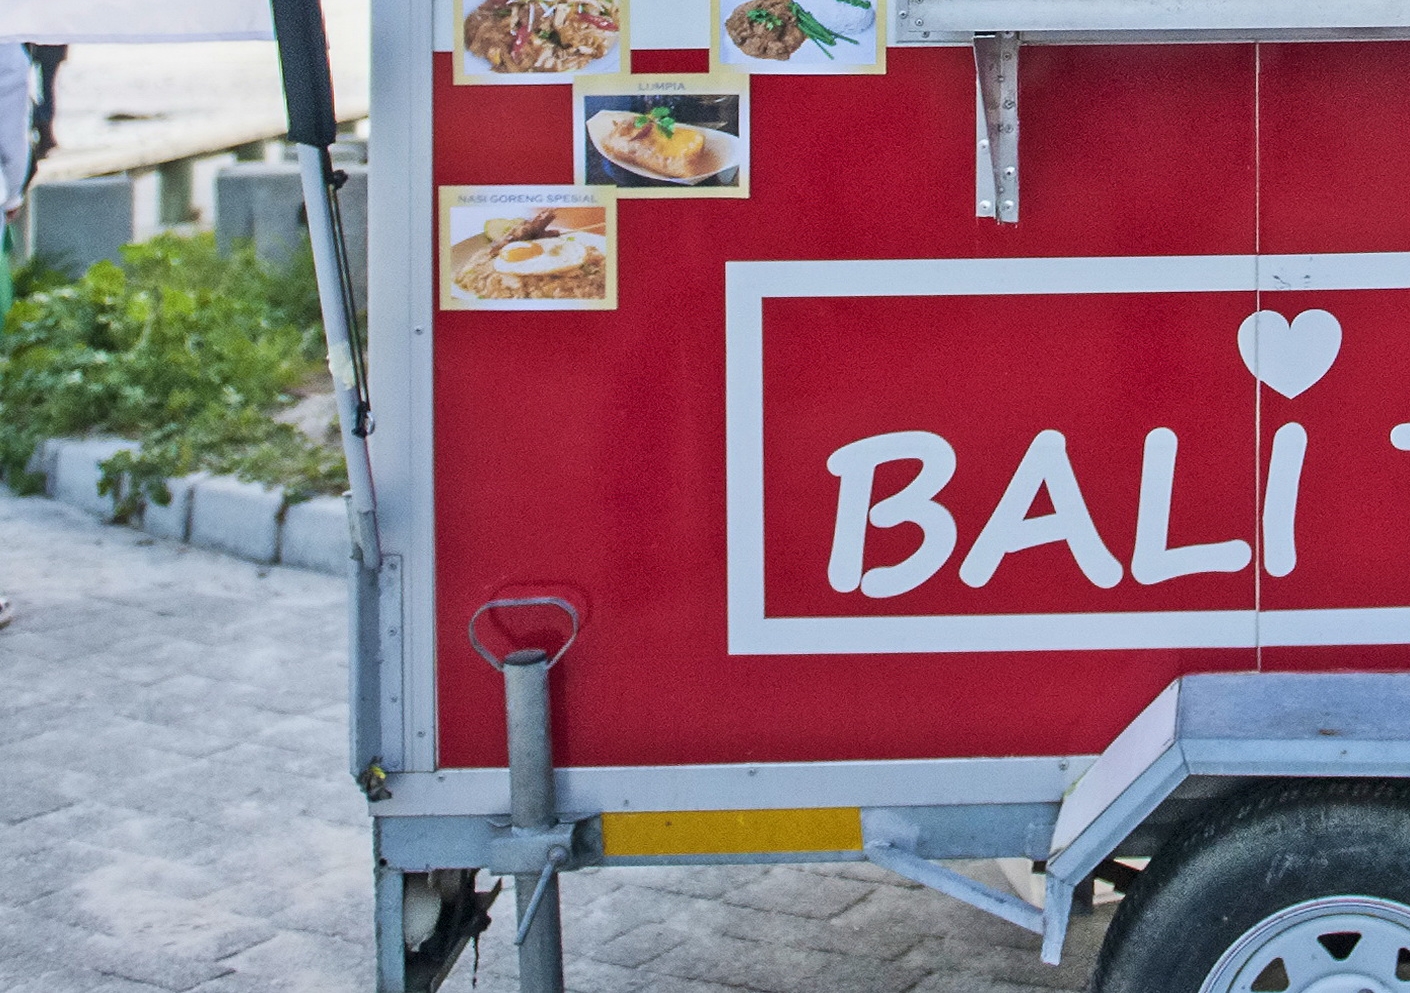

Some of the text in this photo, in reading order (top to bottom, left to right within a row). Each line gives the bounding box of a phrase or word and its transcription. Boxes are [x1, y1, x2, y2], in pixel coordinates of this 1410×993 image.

[638, 82, 686, 91] LUMPIA
[457, 194, 598, 204] NASI GORENG SPESIAL
